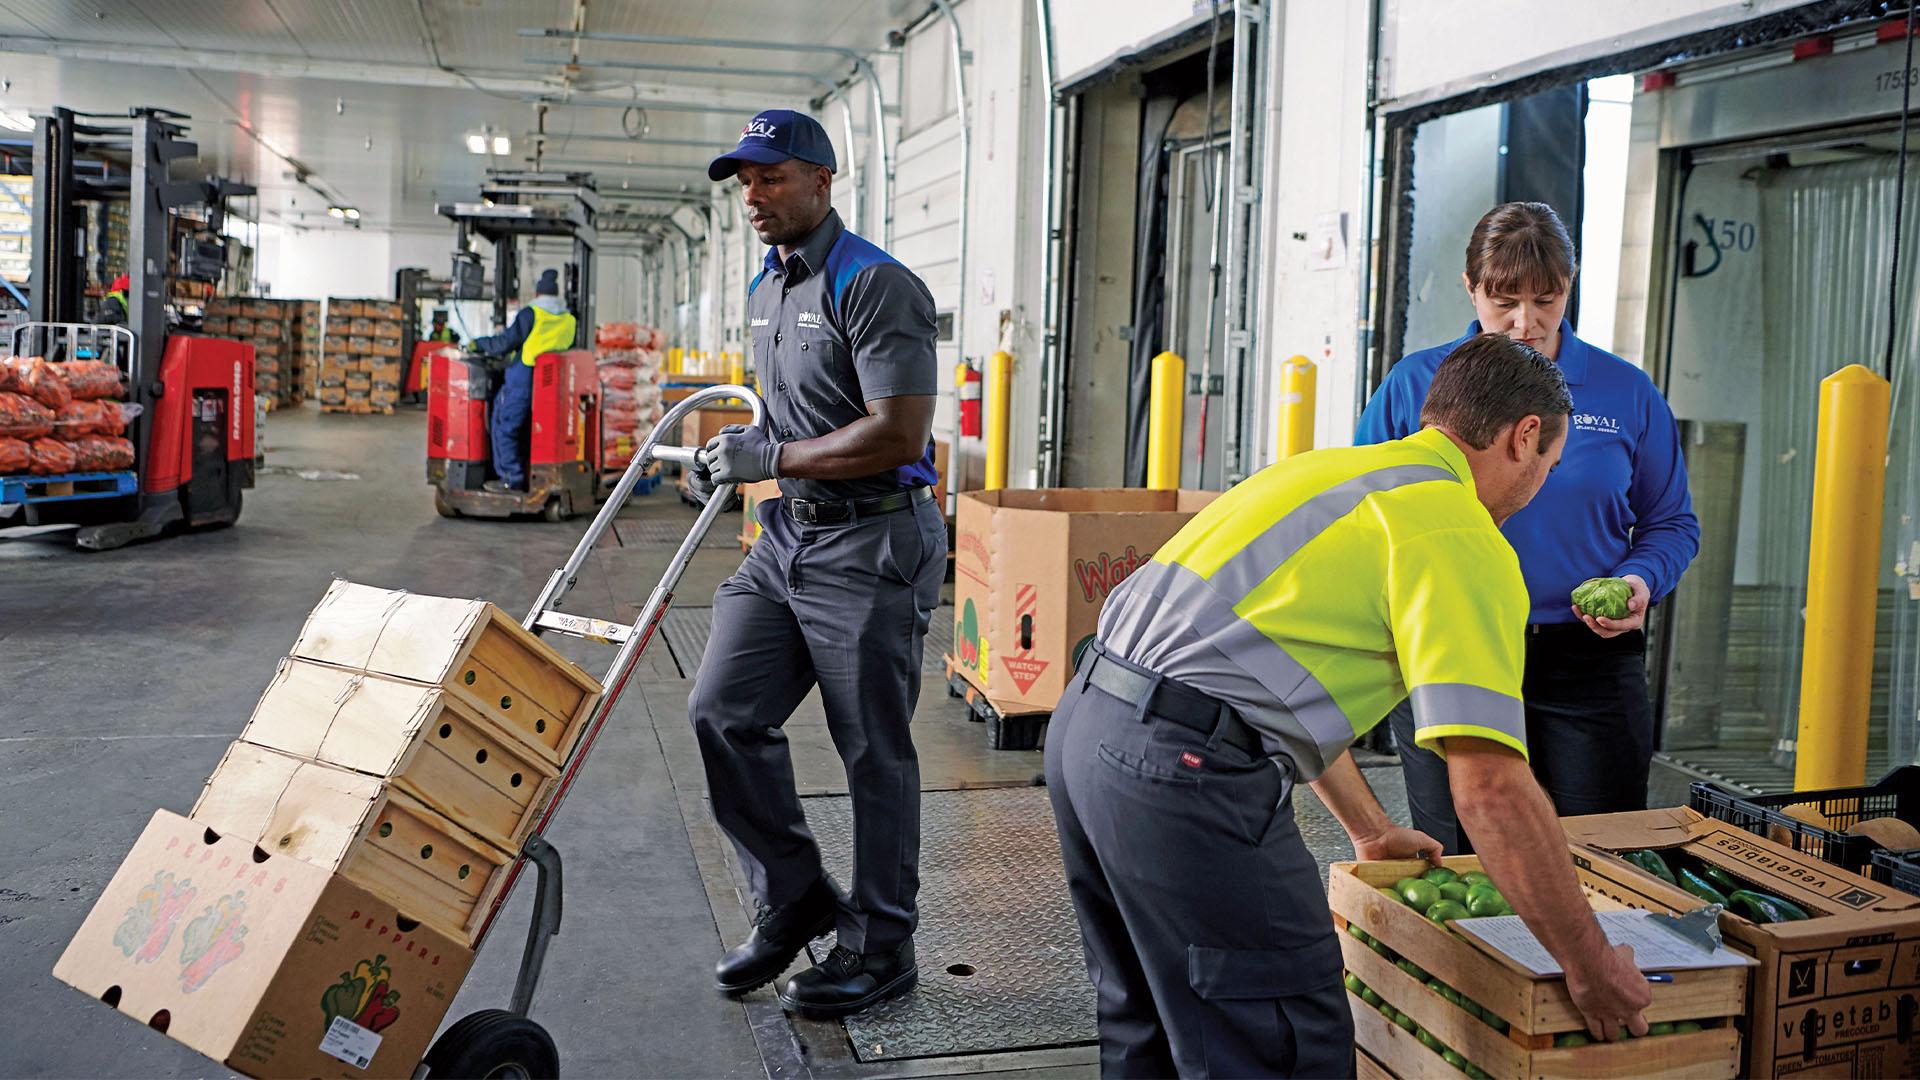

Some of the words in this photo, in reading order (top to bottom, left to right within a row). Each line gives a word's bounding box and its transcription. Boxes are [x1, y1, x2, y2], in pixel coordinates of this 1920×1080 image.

[1572, 413, 1620, 430] ROYAL
[1008, 660, 1042, 672] WATCH
[1013, 671, 1037, 681] STEP
[166, 836, 289, 893] PEPPERS
[1716, 838, 1828, 889] vegetables
[350, 909, 441, 966] PEPPERS
